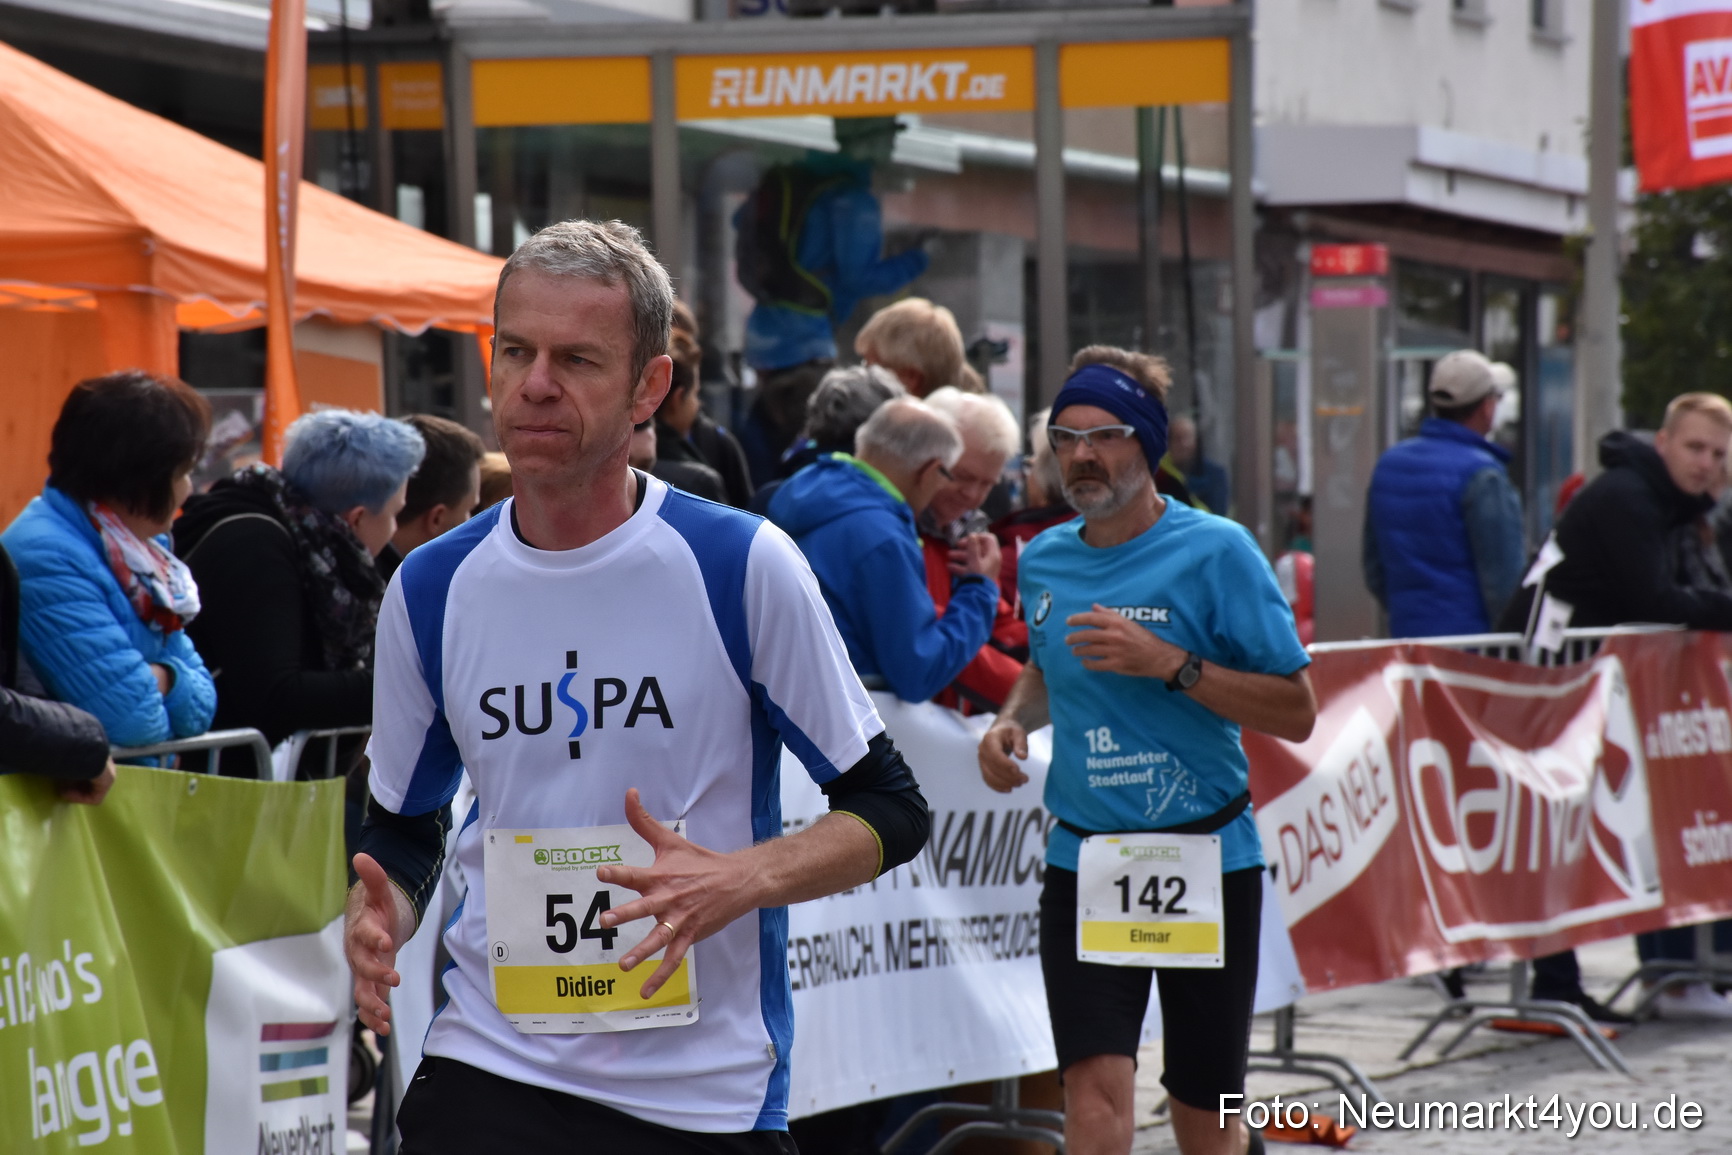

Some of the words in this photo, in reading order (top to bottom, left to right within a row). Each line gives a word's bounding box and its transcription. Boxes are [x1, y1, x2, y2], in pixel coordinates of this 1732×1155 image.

[711, 61, 1006, 106] RUNMARKT.DE
[1693, 57, 1732, 97] AV
[1110, 606, 1170, 623] OCK
[480, 660, 674, 750] SUSPA
[1085, 726, 1119, 753] 18.
[1086, 751, 1169, 770] Neumarkter
[1088, 767, 1154, 788] Stadtlauf
[1278, 793, 1343, 895] DAS
[1338, 740, 1388, 852] NEUE
[551, 845, 622, 865] BOCK
[1114, 875, 1187, 914] 142
[546, 890, 619, 953] 54
[1130, 929, 1171, 943] Elmar
[497, 947, 503, 957] D
[556, 976, 616, 998] Didier
